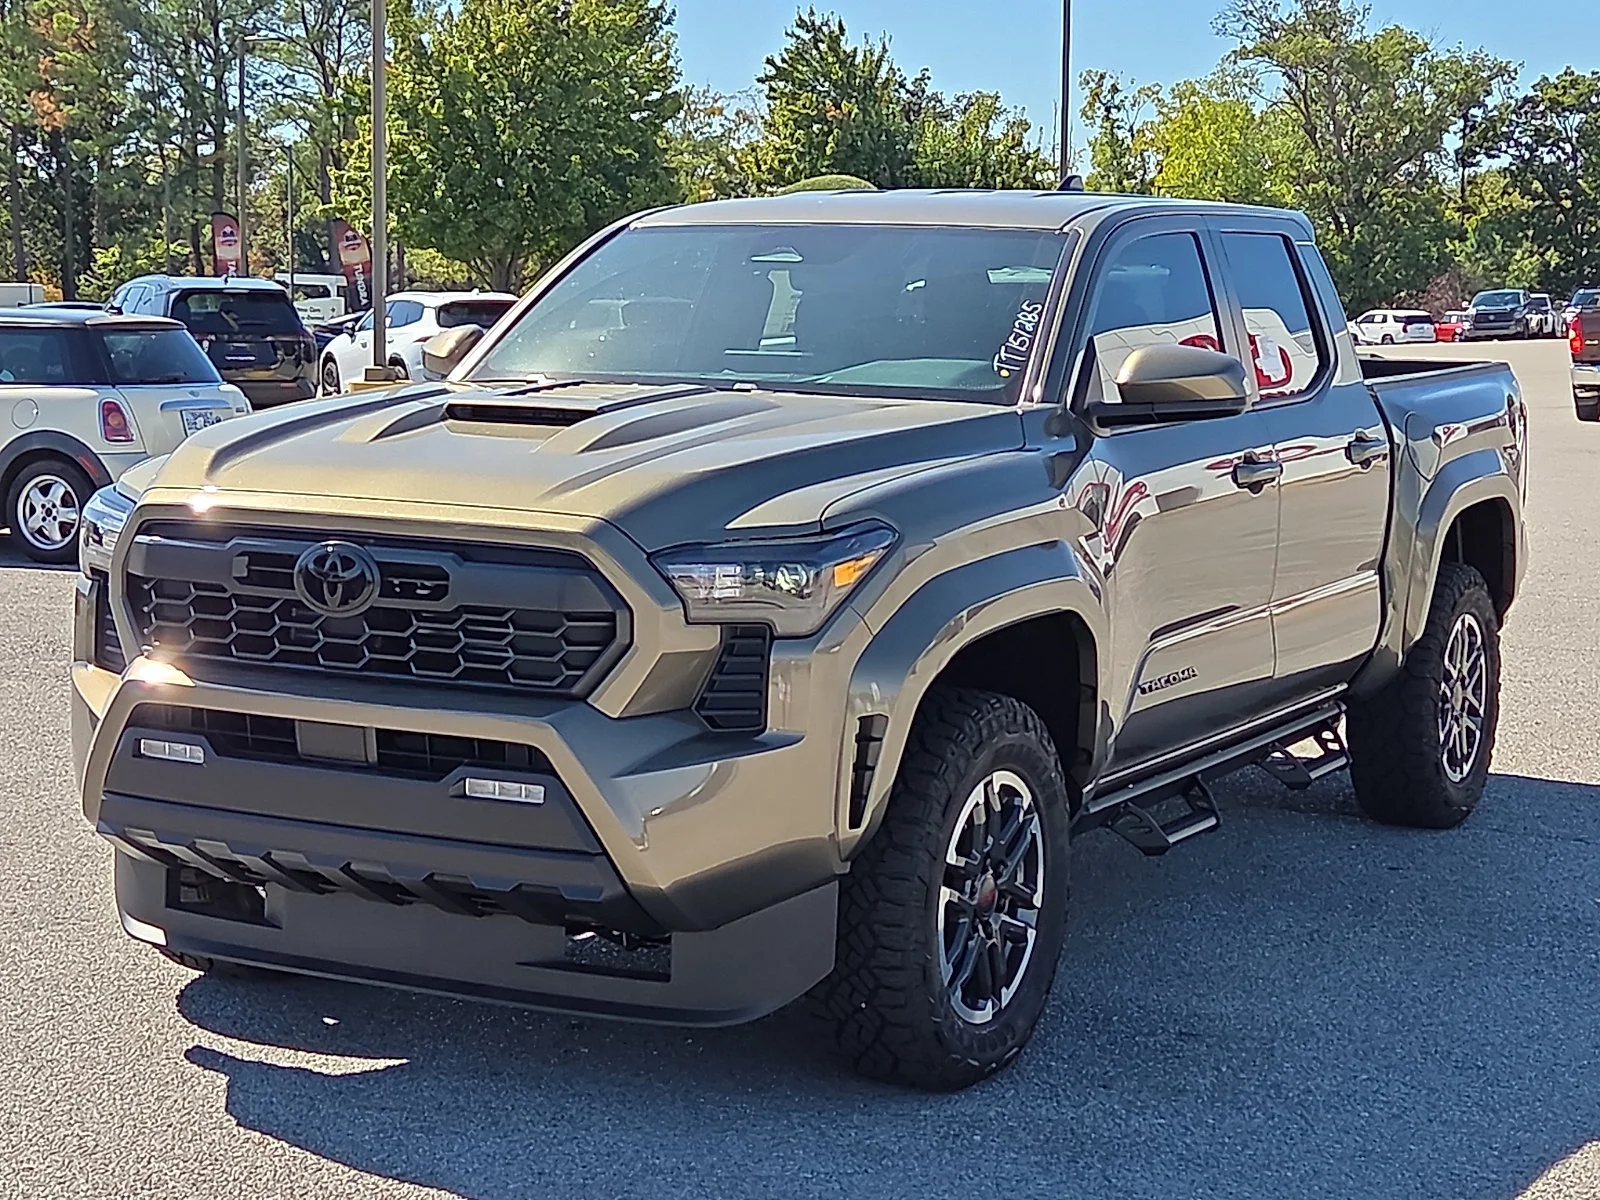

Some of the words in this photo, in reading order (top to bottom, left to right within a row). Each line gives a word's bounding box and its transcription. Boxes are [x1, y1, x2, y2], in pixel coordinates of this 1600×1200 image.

[353, 263, 370, 306] TUNDRA
[993, 299, 1043, 372] TT151285
[1140, 666, 1199, 695] TACOMA
